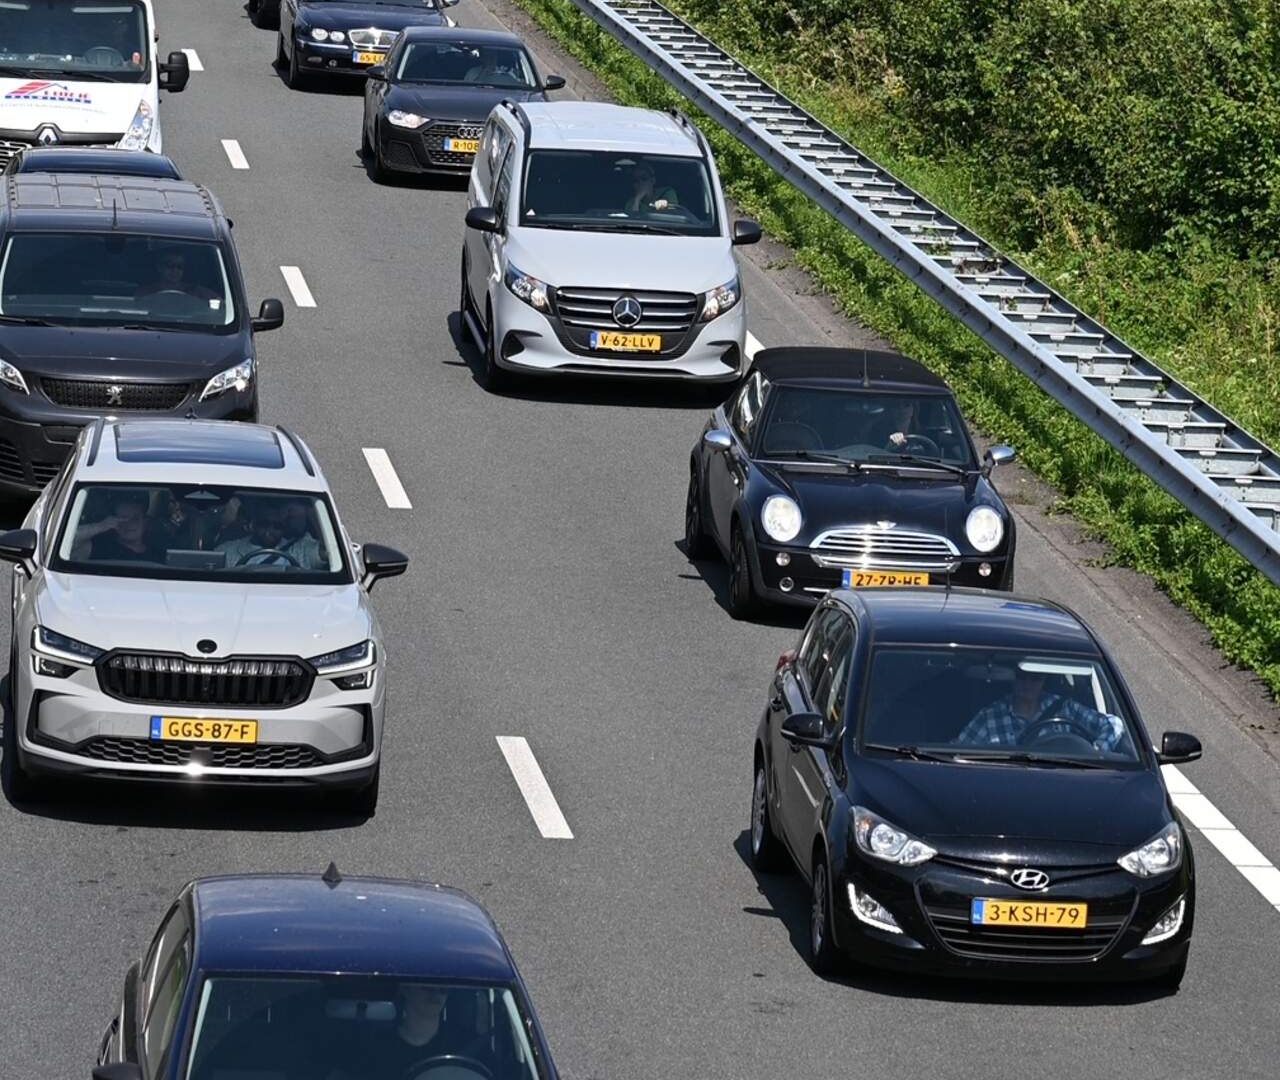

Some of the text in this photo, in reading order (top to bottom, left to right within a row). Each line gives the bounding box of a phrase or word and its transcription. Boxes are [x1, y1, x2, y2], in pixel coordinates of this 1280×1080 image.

[601, 335, 655, 348] V-62-LLV
[168, 721, 250, 739] GGS-87-F
[989, 904, 1080, 924] 3-KSH-79
